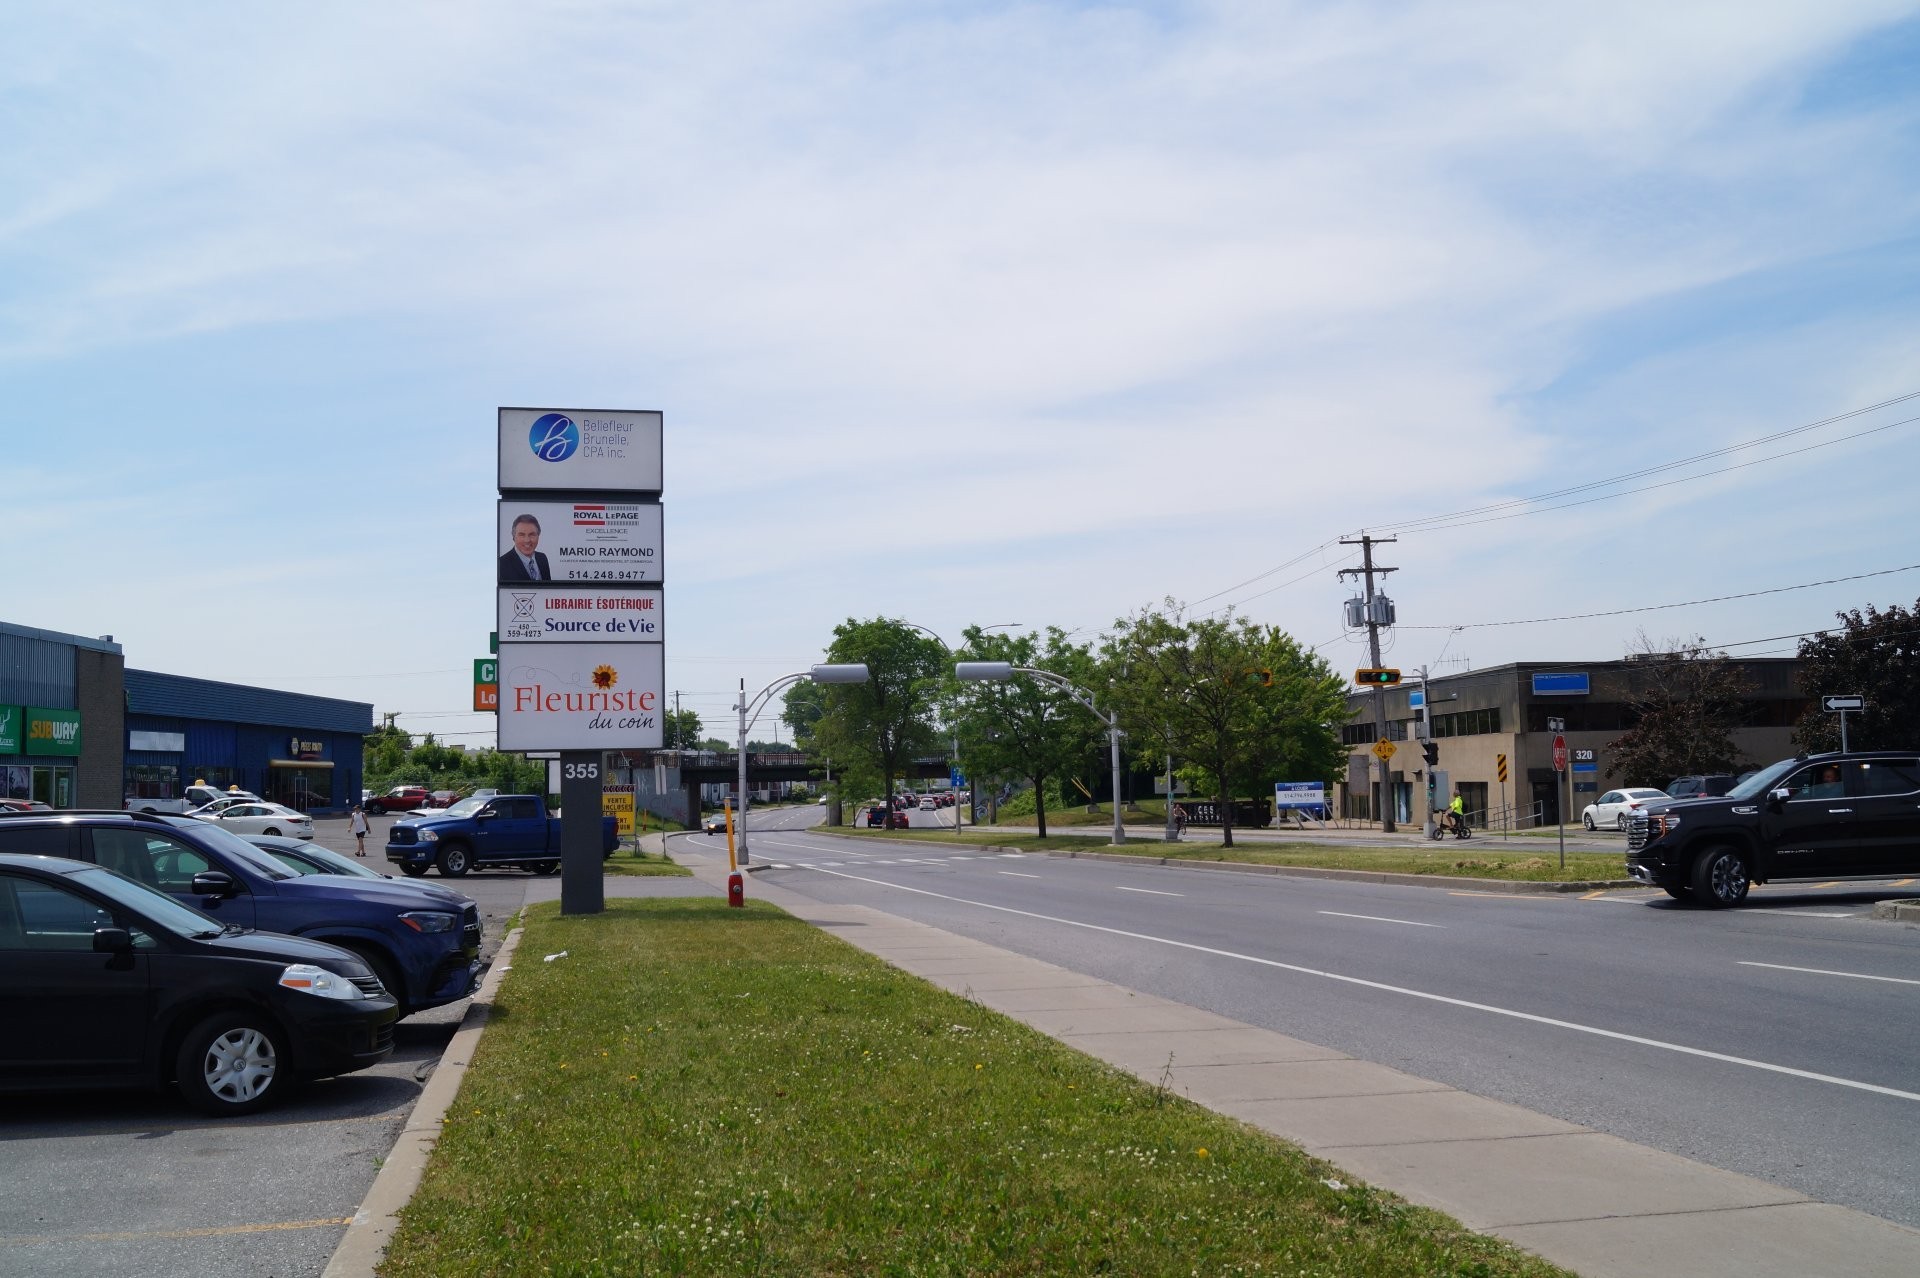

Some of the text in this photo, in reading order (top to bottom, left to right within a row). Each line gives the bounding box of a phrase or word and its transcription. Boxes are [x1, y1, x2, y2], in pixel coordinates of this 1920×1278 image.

[583, 419, 634, 432] Bellefleur
[583, 433, 629, 446] Brunelle,
[583, 446, 626, 458] CPA inc.
[573, 511, 603, 520] ROYAL
[559, 547, 654, 557] MARIO RAYMOND
[568, 570, 645, 579] 514.248.9477
[545, 596, 654, 611] LIBRAIRIE ÉSOTÉRIQUE
[545, 618, 655, 633] Source de Vie
[507, 630, 542, 638] 359-4273
[513, 685, 655, 712] Fleuriste
[589, 711, 654, 729] du coin
[30, 720, 79, 740] SUBWAY
[1576, 750, 1593, 760] 320
[565, 763, 598, 779] 355
